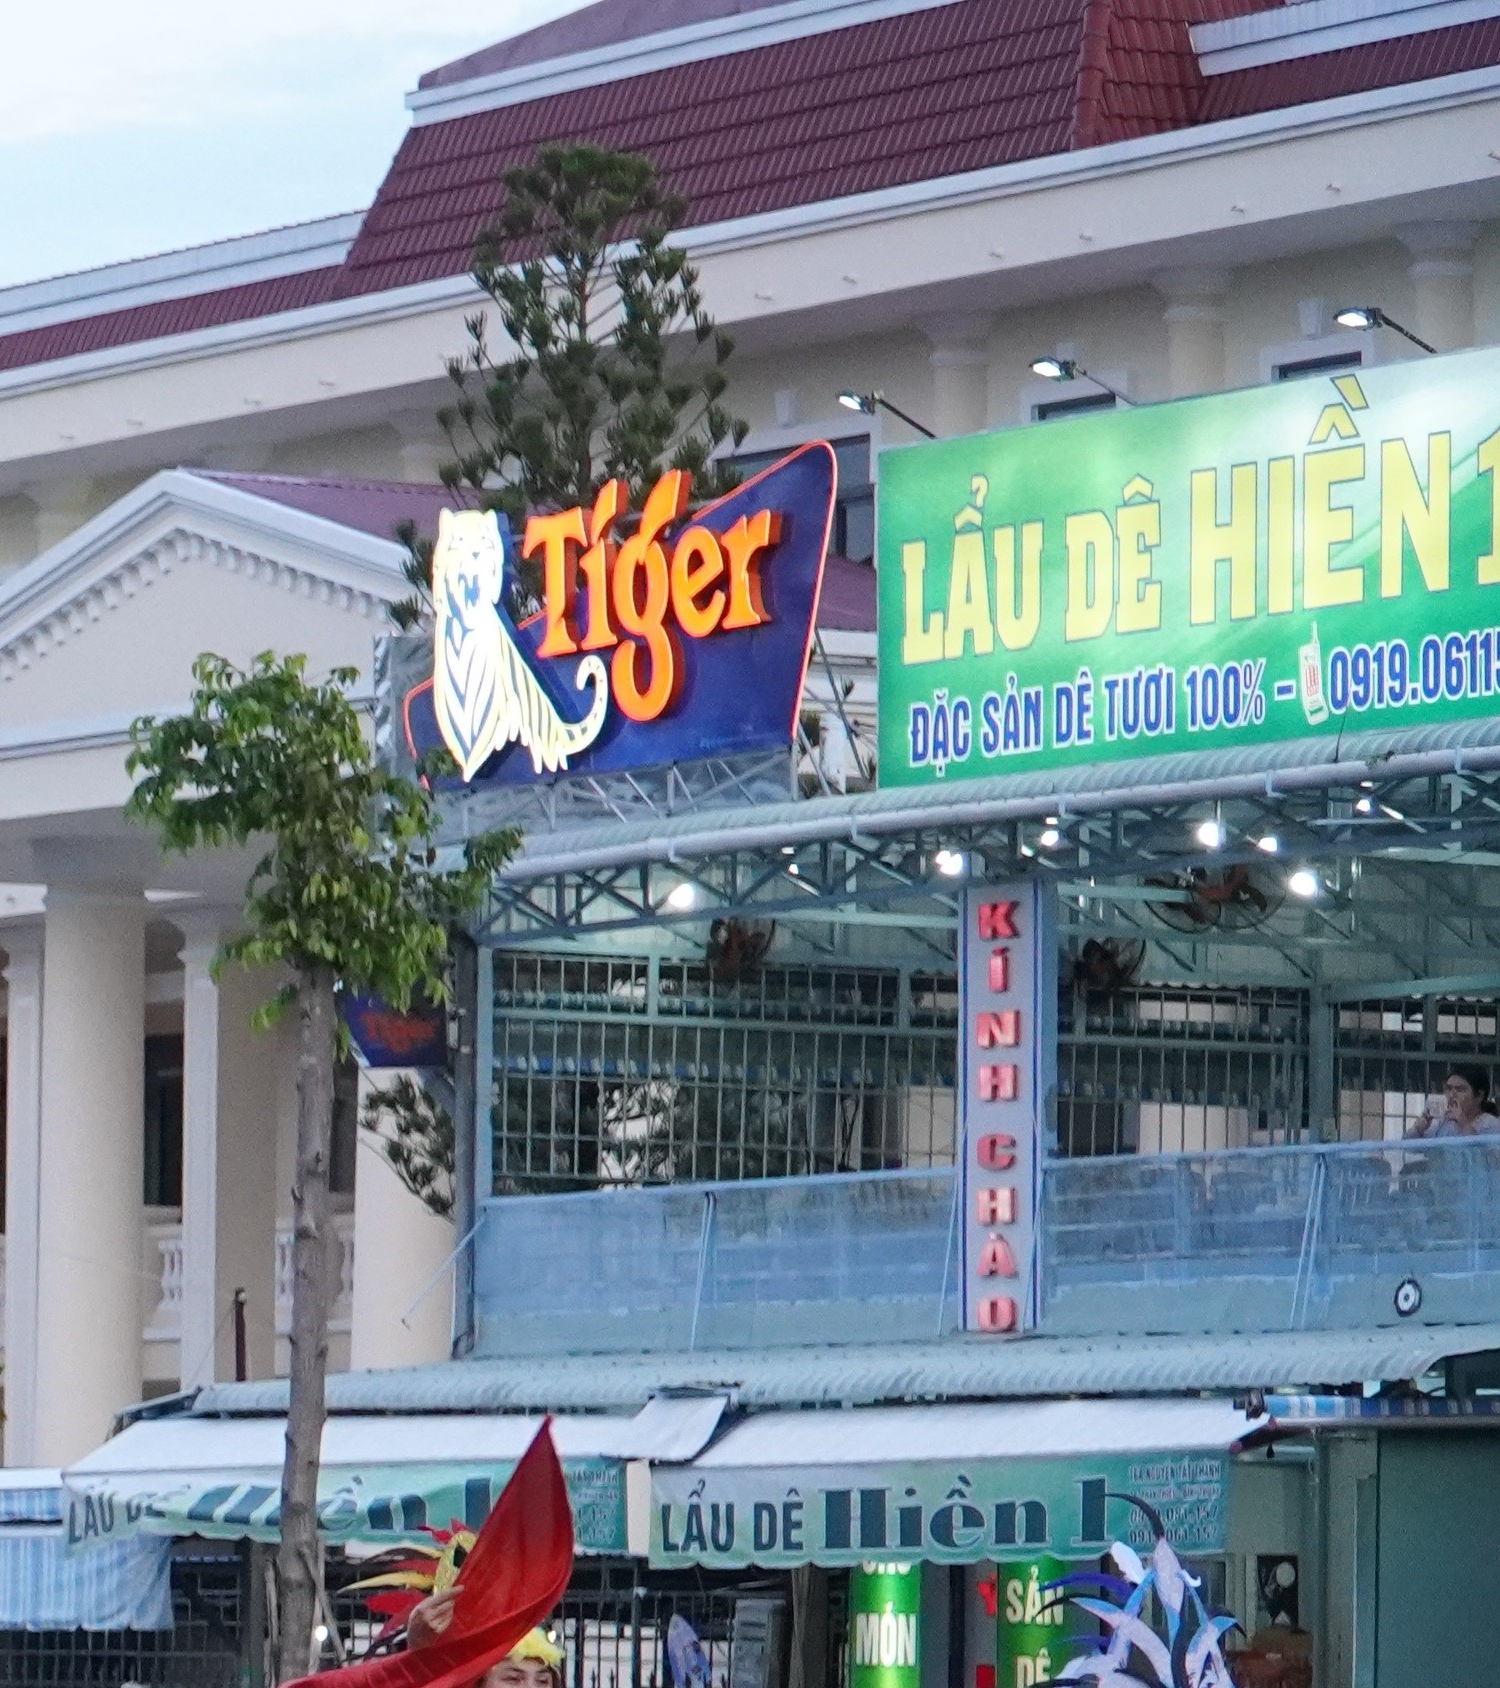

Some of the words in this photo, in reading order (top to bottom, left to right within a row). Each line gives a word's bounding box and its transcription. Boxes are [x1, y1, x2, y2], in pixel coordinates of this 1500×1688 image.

[522, 469, 780, 722] Tiger
[901, 475, 1044, 665] LẨU
[1064, 475, 1162, 644] DÊ
[1190, 374, 1452, 626] HIỀN
[911, 690, 970, 775] ĐẶC
[982, 674, 1042, 754] SẢN
[1055, 668, 1093, 744] DÊ
[1105, 666, 1175, 740] TƯƠI
[1185, 658, 1266, 731] 100%
[1329, 630, 1500, 713] 0919.0611
[977, 900, 1019, 1101] KÍNH
[976, 1132, 1018, 1332] CHÀO
[661, 1478, 735, 1551] LẨU
[753, 1487, 804, 1551] DÊ
[818, 1474, 1050, 1549] Hiền
[855, 1602, 917, 1667] MÓN
